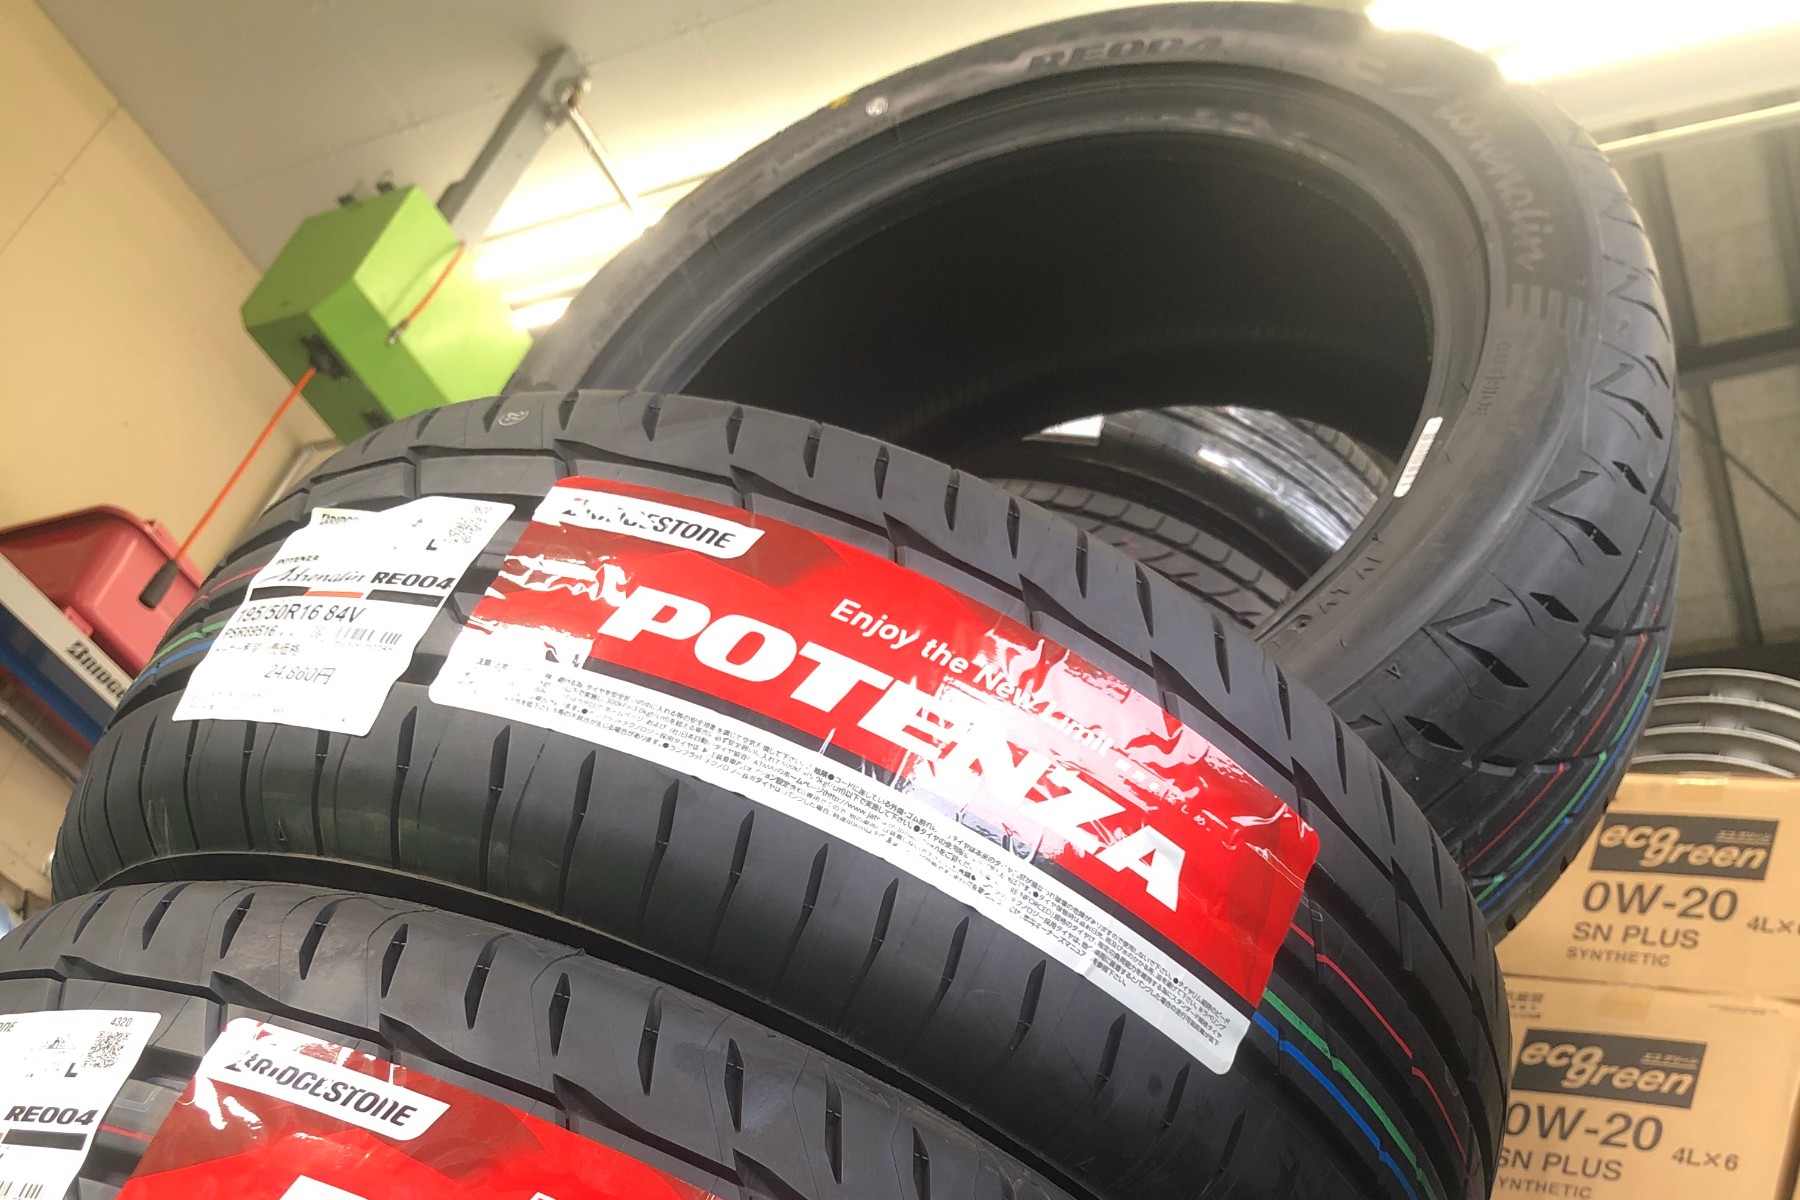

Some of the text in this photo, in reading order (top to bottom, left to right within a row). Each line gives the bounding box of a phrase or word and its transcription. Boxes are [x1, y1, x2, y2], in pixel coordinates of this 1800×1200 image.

[370, 571, 456, 590] RE004
[323, 604, 367, 623] 84V
[829, 598, 920, 650] Enjoy
[920, 638, 969, 674] the
[597, 585, 1187, 912] POTENZA
[1582, 880, 1739, 923] 0W-20
[1572, 921, 1700, 949] SN PLUS
[1566, 945, 1671, 968] SYNTHETIC
[110, 1016, 133, 1028] 4320
[64, 1062, 78, 1078] L
[3, 1104, 98, 1127] RE004
[1507, 1100, 1664, 1153] 0W-20
[1541, 1150, 1624, 1181] PLUS
[1498, 1175, 1592, 1200] YNTHETIC
